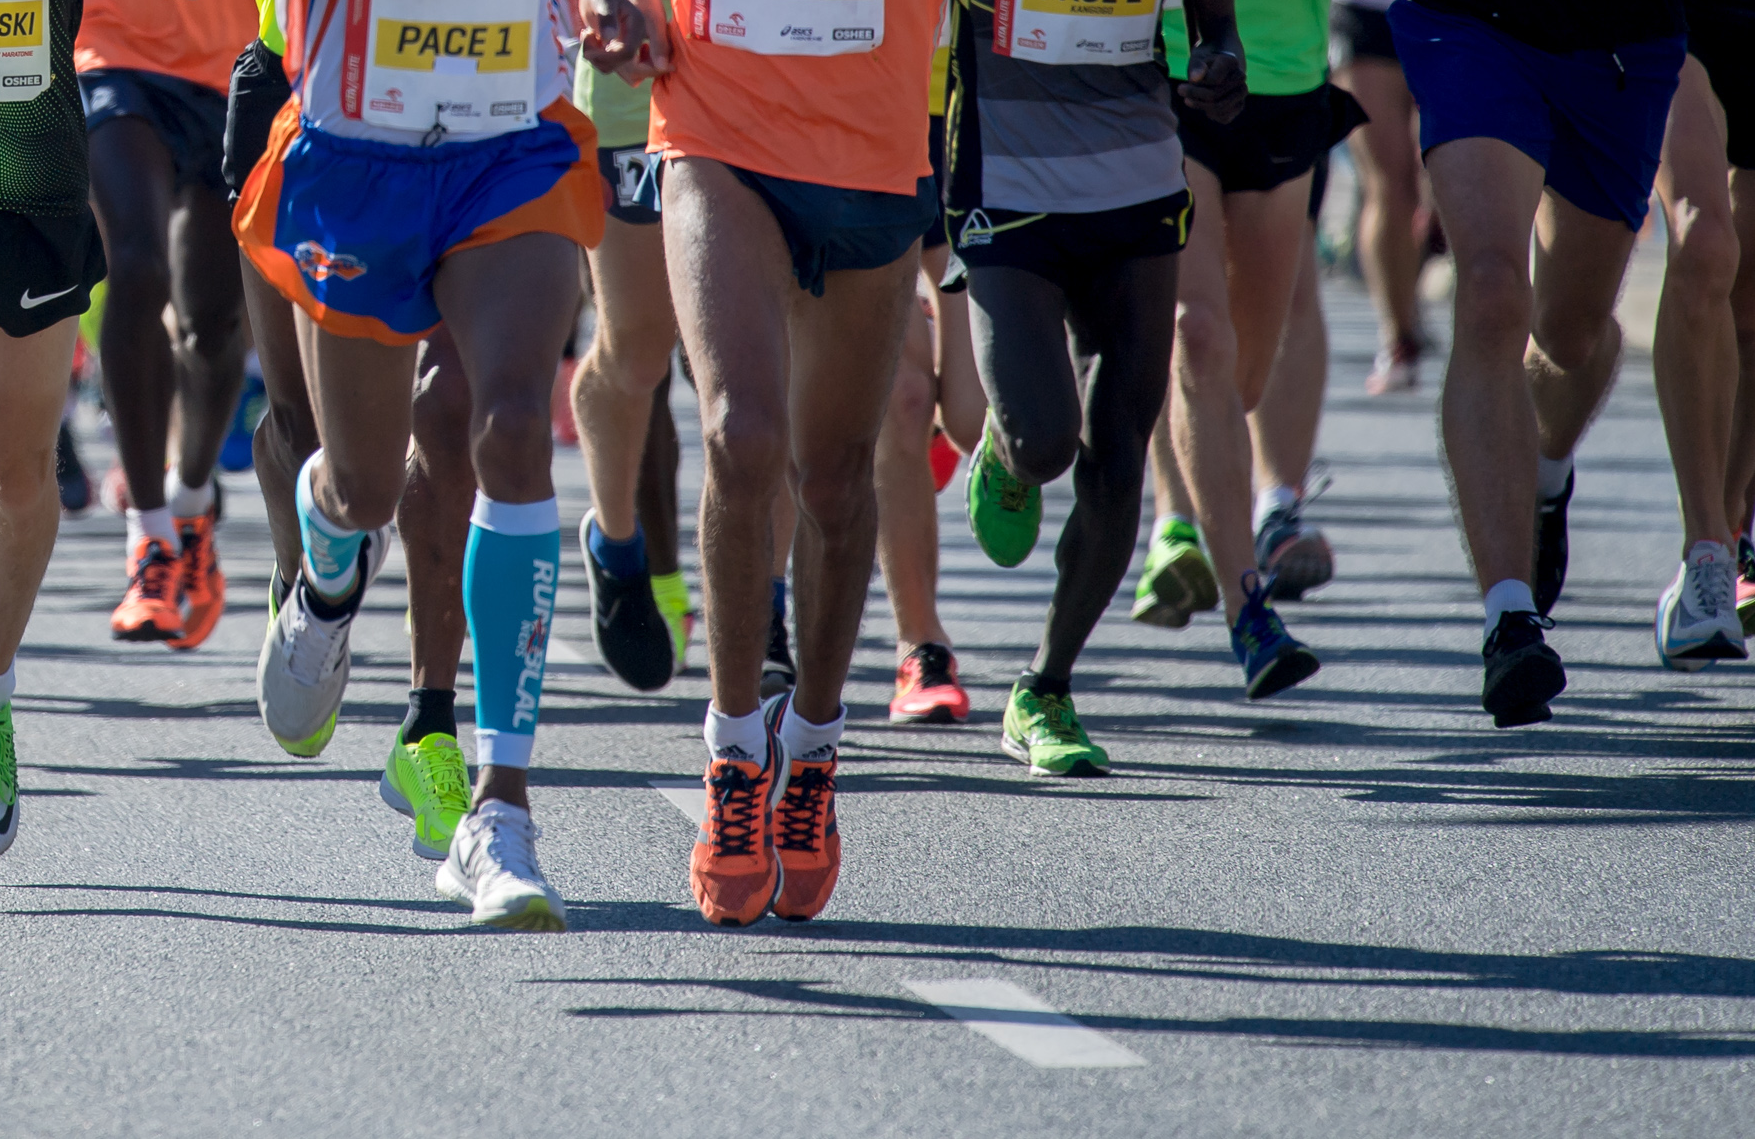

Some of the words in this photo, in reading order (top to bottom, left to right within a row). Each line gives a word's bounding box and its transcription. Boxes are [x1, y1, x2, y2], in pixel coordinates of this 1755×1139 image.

[834, 28, 873, 40] OSHEE
[397, 25, 487, 56] PACE
[494, 26, 511, 56] 1
[1, 50, 34, 58] MARATONIE
[4, 76, 41, 86] OSHEE
